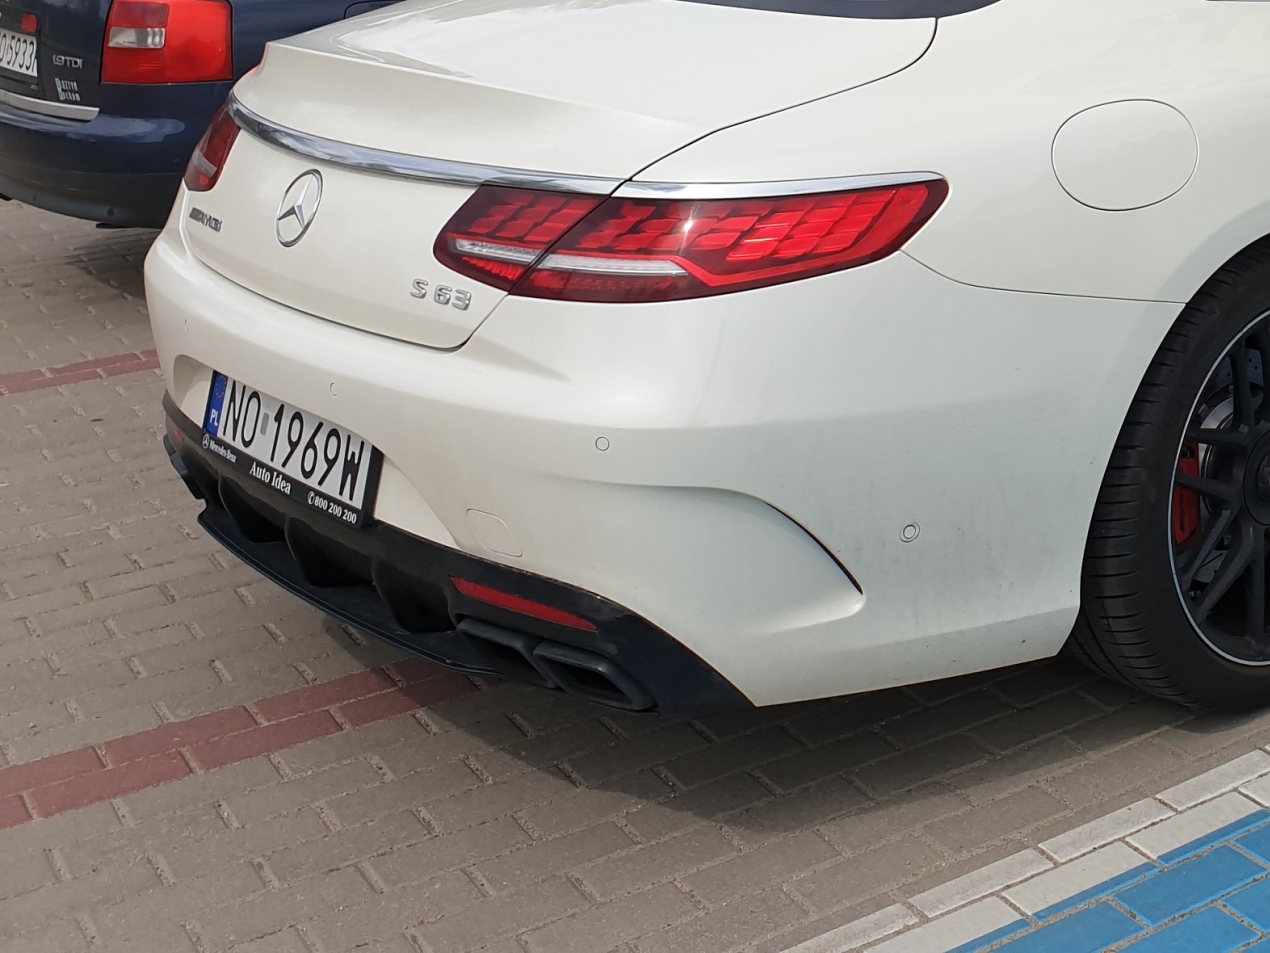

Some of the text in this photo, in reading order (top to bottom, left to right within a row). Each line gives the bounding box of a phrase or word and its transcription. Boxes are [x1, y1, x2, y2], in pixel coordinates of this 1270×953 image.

[410, 278, 472, 311] S 63
[209, 408, 219, 427] PL
[223, 380, 365, 502] NO 1969W
[249, 461, 292, 495] Auto Idea
[314, 495, 357, 524] 800 200 200
